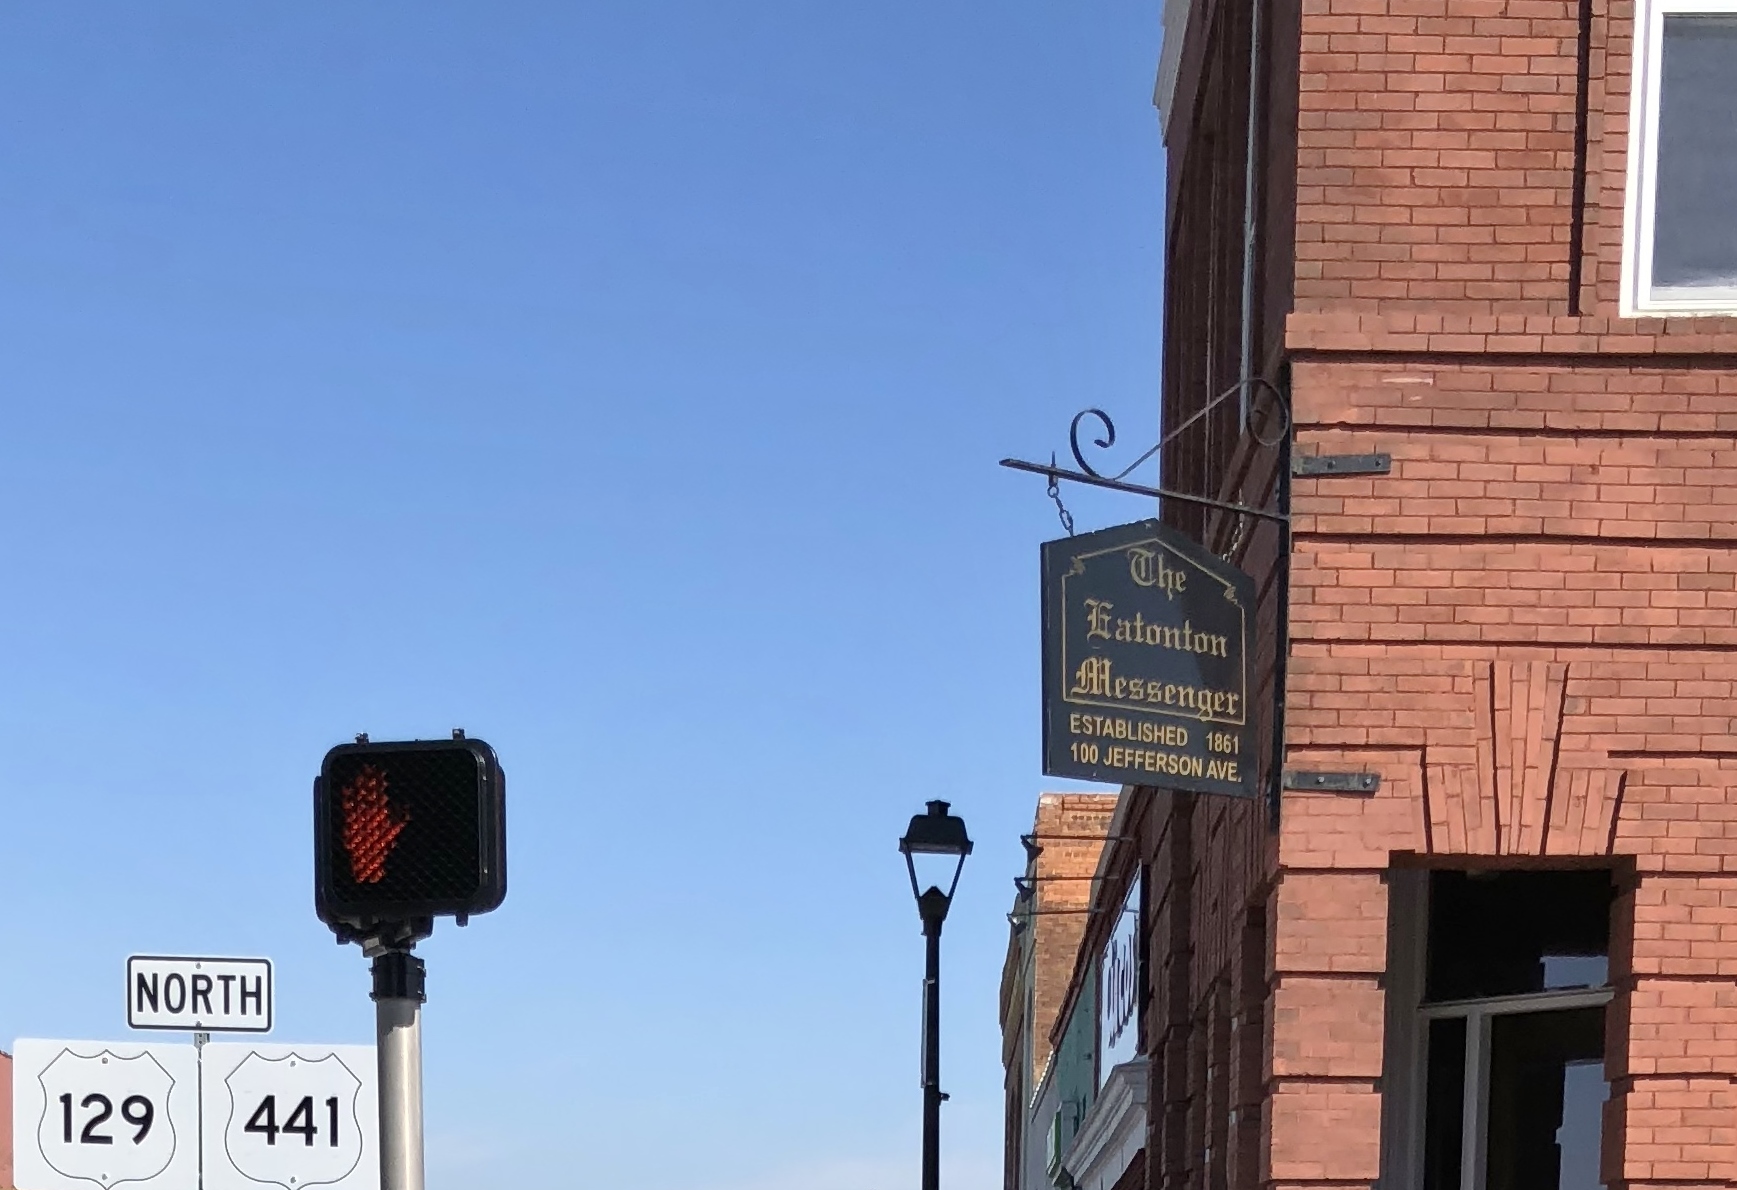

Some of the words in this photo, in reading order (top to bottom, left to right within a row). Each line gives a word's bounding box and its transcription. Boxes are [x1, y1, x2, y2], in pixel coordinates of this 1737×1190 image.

[1127, 549, 1187, 600] The
[1083, 598, 1228, 658] Eatonton
[1070, 656, 1240, 721] Messenger
[1070, 713, 1188, 746] ESTABLISHED
[1206, 731, 1240, 755] 1861
[1070, 742, 1099, 764] 100
[1103, 747, 1202, 777] JEFFERSON
[1206, 760, 1242, 783] AVE.
[136, 972, 263, 1016] NORTH
[58, 1092, 154, 1146] 129
[244, 1094, 339, 1148] 441
